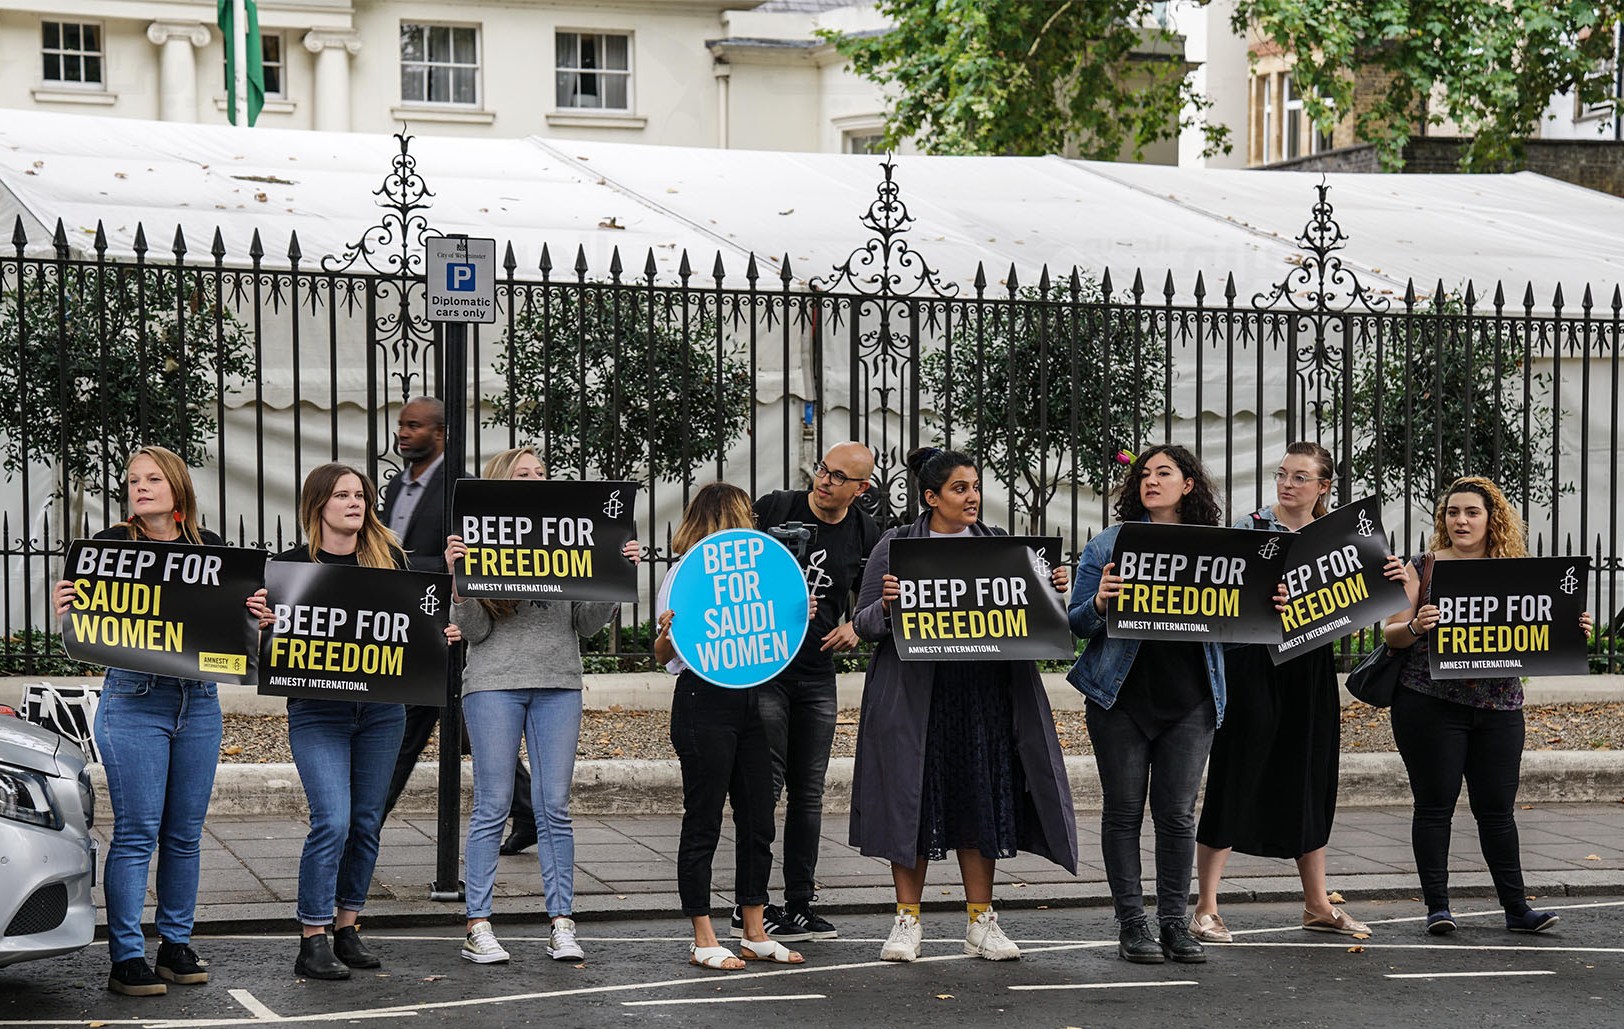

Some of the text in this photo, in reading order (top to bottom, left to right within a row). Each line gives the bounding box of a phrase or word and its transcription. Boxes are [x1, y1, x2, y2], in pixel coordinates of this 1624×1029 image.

[453, 266, 472, 289] P
[432, 296, 491, 307] Diplomatic
[436, 309, 486, 319] cars only
[463, 515, 595, 546] BEEP FOR
[75, 547, 222, 586] BEEP FOR
[464, 547, 593, 578] FREEDOM
[702, 537, 764, 574] BEEP
[1119, 551, 1247, 586] BEEP FOR
[1316, 544, 1364, 584] FOR
[73, 578, 162, 616] SAUDI
[467, 583, 563, 593] AMNESTY INTERNATIONAL
[713, 570, 761, 606] FOR
[899, 577, 1029, 609] BEEP FOR
[1117, 583, 1240, 617] FREEDOM
[1281, 573, 1369, 632] REEDOM
[272, 604, 410, 643] BEEP FOR
[704, 600, 776, 639] SAUDI
[901, 609, 1028, 640] FREEDOM
[1439, 595, 1553, 624] BEEP FOR
[71, 613, 184, 653] WOMEN
[1117, 620, 1210, 632] AMNESTY INTERNATIONAL
[1278, 615, 1352, 653] AMNESTY INTERNATIONAL
[1437, 625, 1549, 654] FREEDOM
[203, 656, 229, 665] AMNESTY
[270, 638, 404, 676] FREEDOM
[696, 630, 789, 673] WOMEN
[908, 645, 1000, 654] AMNESTY INTERNATIONAL
[1439, 660, 1523, 669] AMNESTY INTERNATIONAL
[269, 676, 369, 692] AMNESTY INTERNATIONAL
